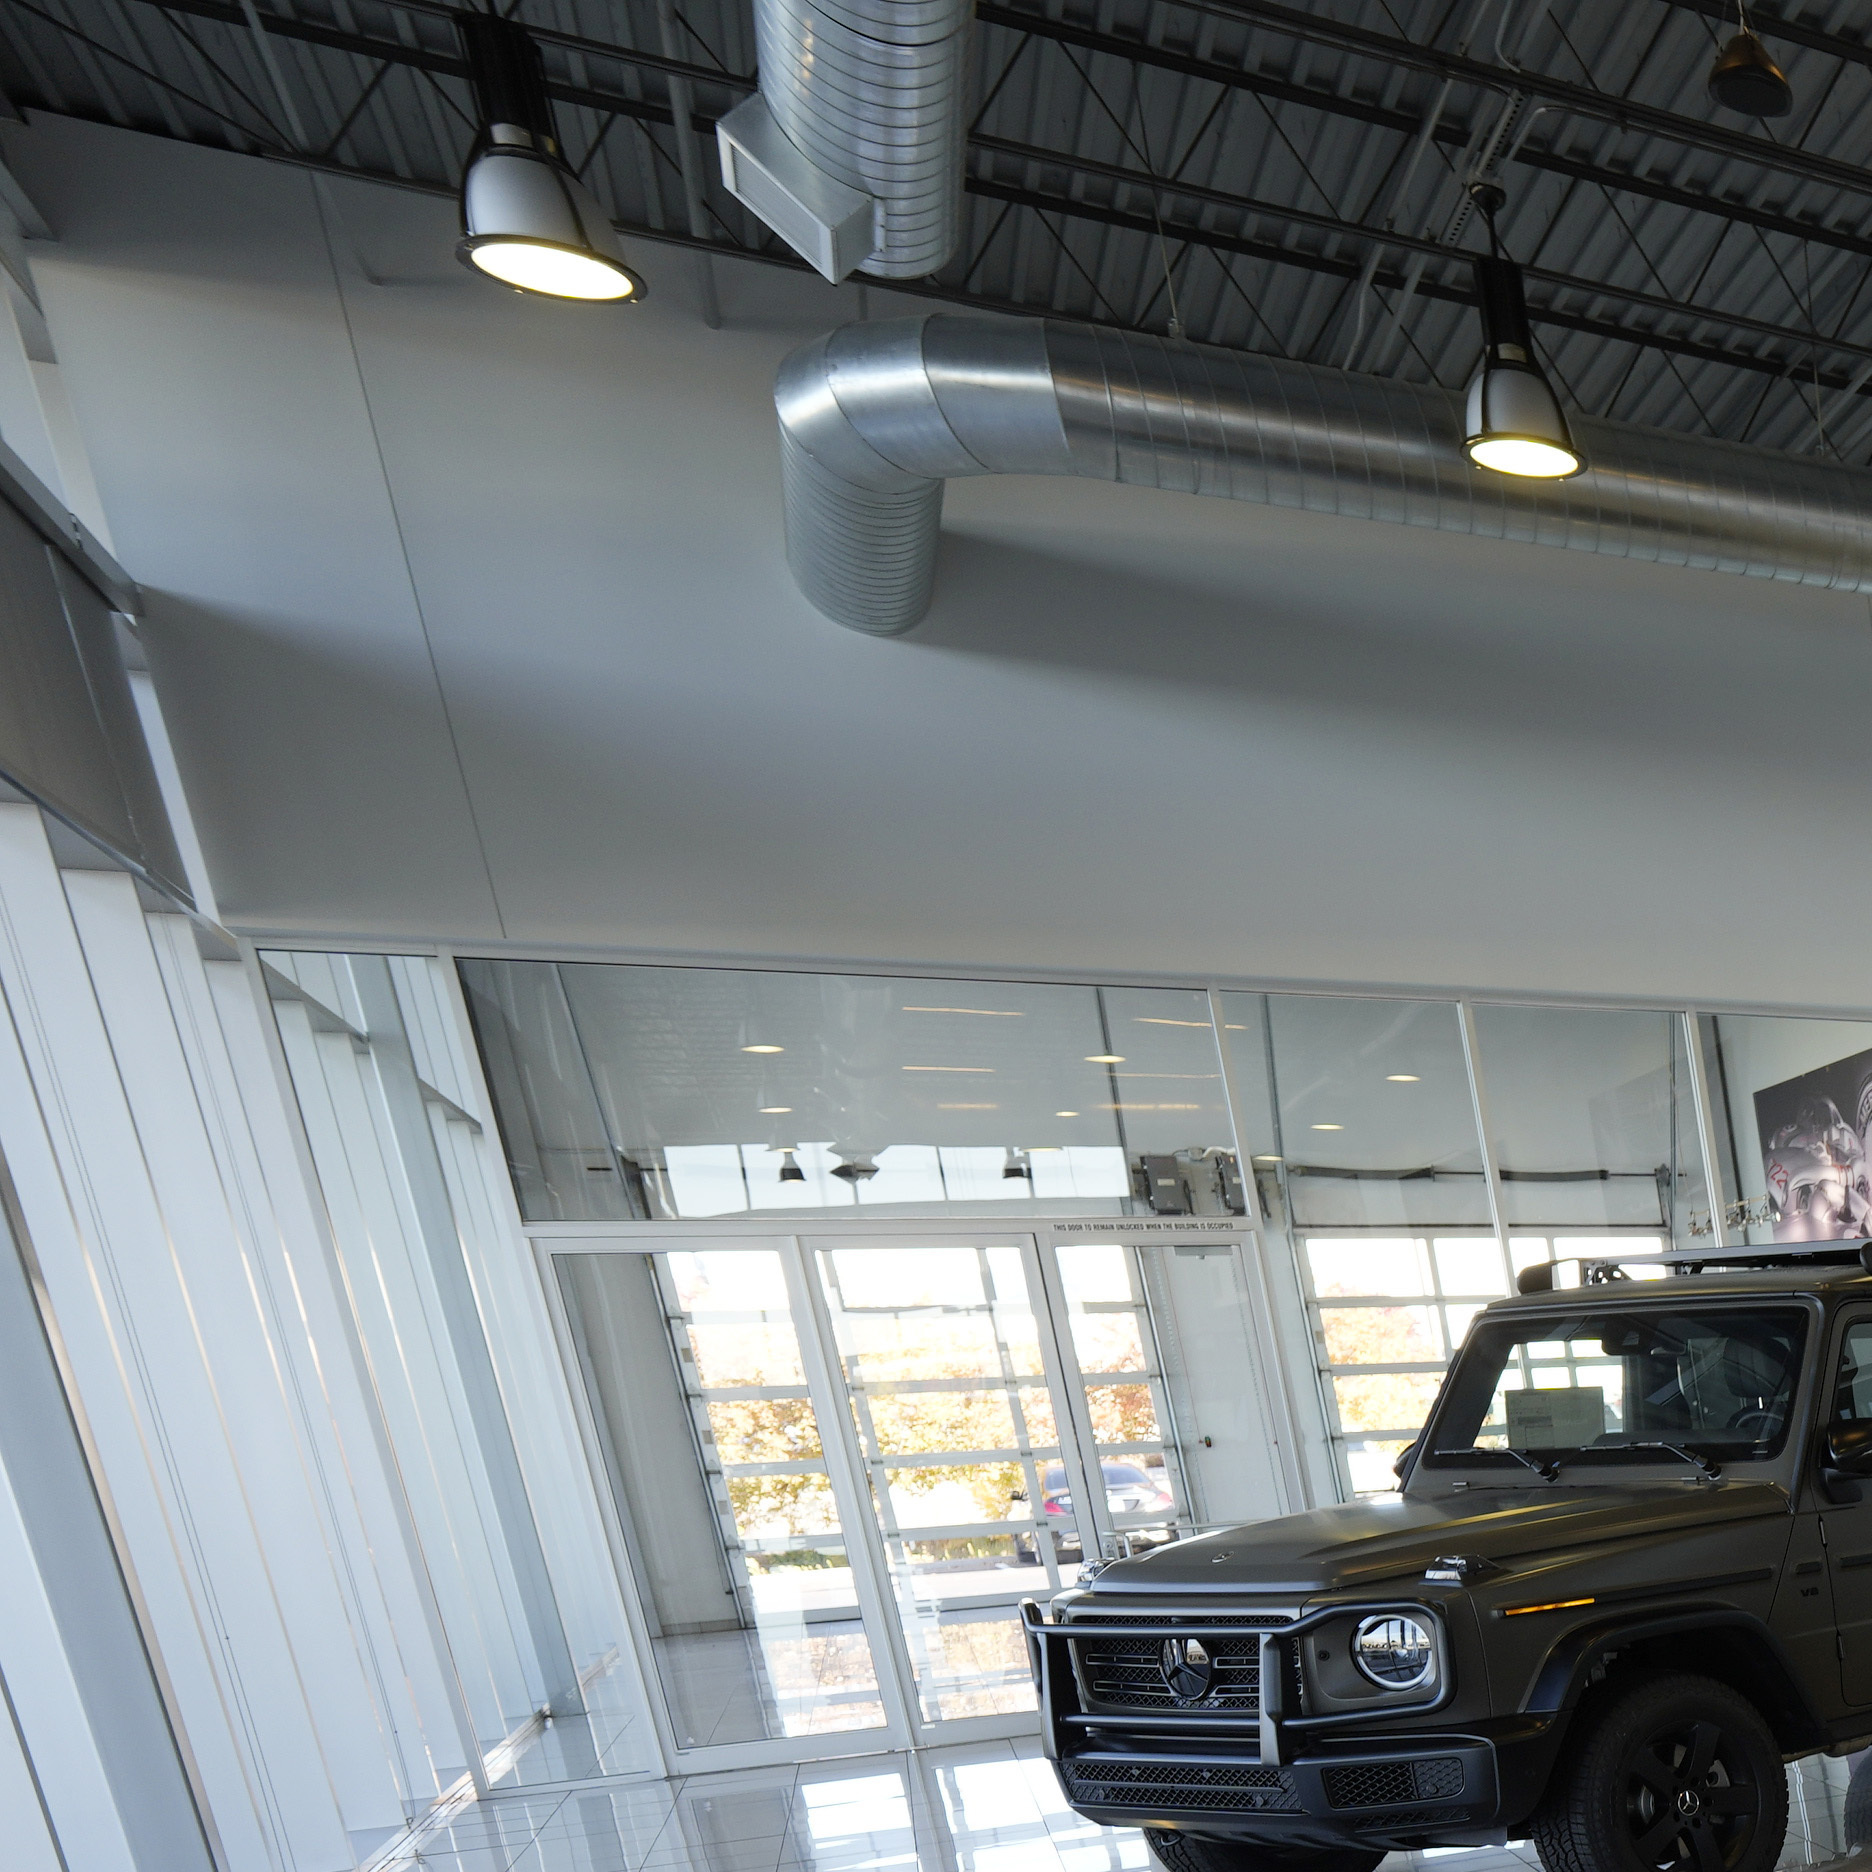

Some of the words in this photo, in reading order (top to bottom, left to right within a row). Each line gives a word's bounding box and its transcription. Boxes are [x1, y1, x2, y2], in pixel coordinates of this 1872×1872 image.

[1053, 1223, 1067, 1231] THIS
[1067, 1223, 1083, 1231] DOOR
[1093, 1223, 1115, 1231] REMAIN
[1116, 1222, 1144, 1231] UNLOCKED
[1146, 1222, 1162, 1230] WHEN
[1163, 1222, 1173, 1230] THE
[1174, 1222, 1199, 1230] BUILDING
[1207, 1222, 1234, 1230] OCCUPIED
